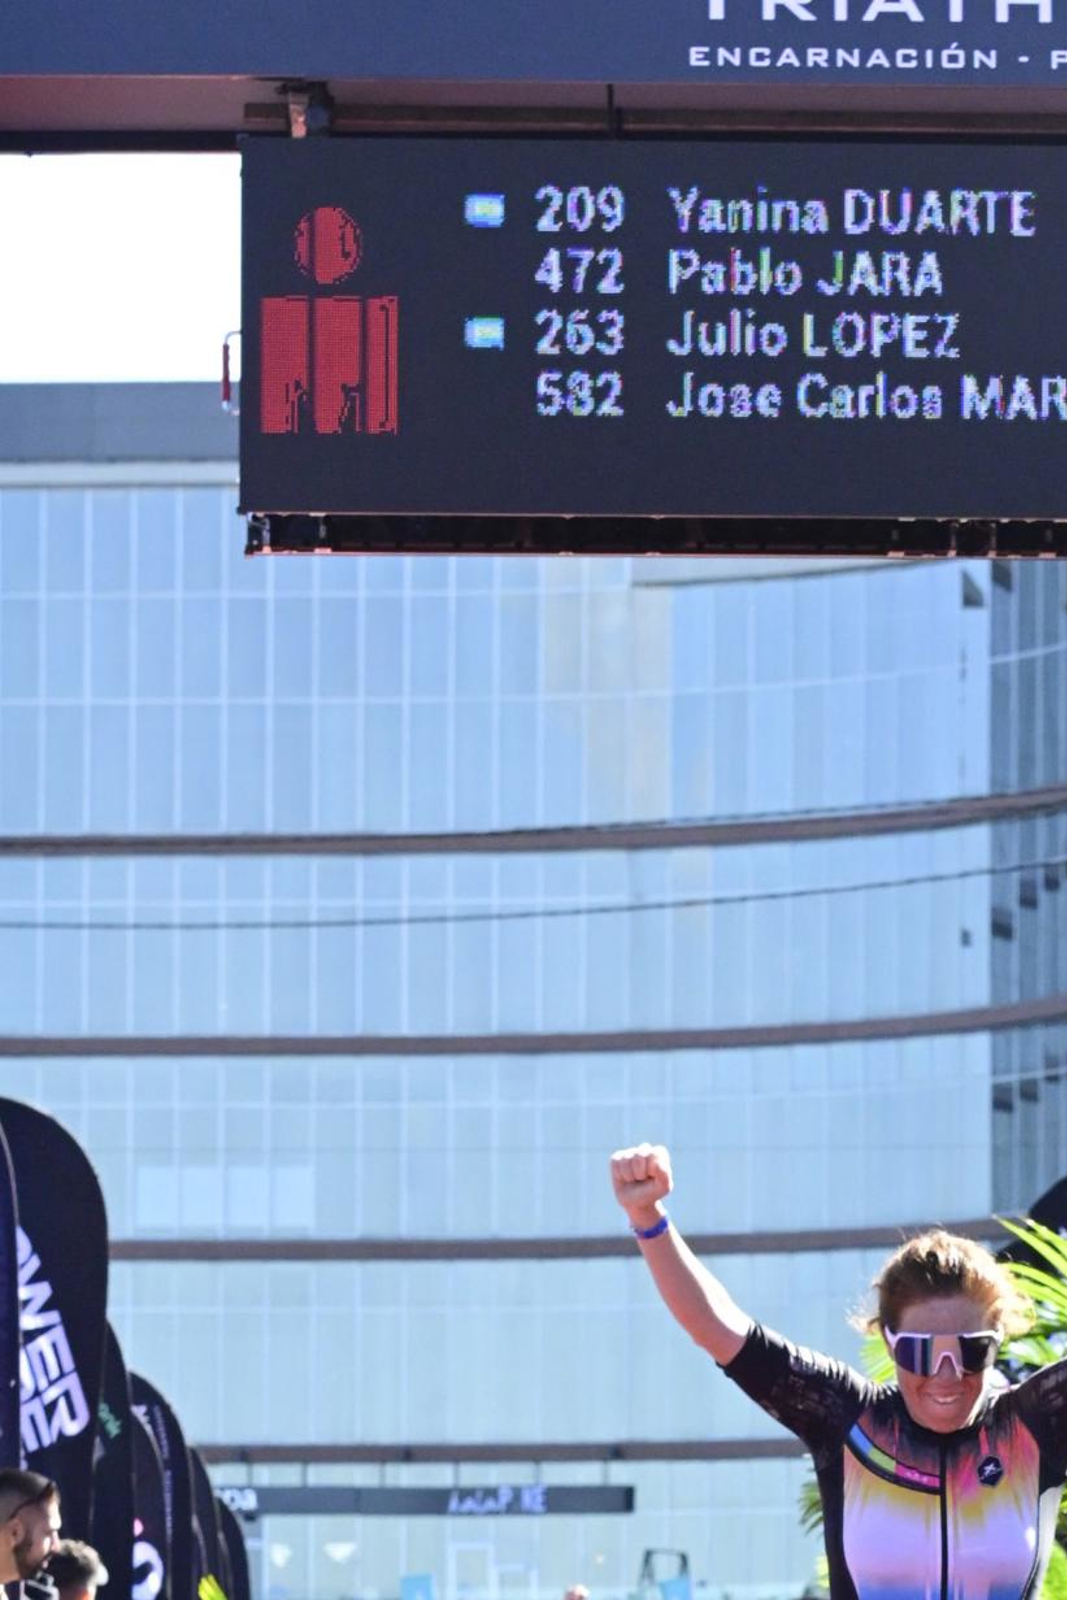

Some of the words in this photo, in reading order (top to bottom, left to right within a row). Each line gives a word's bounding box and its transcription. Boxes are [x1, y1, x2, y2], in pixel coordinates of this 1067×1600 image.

[689, 42, 998, 70] ENCARNACIÓN
[535, 184, 625, 232] 209
[667, 183, 829, 234] Yanina
[844, 187, 1037, 238] DUARTE
[535, 246, 625, 294] 472
[668, 246, 802, 297] Pablo
[816, 250, 943, 297] JARA
[535, 308, 625, 356] 263
[667, 308, 788, 357] Julio
[803, 312, 961, 359] LOPEZ
[536, 370, 625, 417] 582
[667, 371, 782, 419] Jose
[798, 371, 943, 420] Carlos
